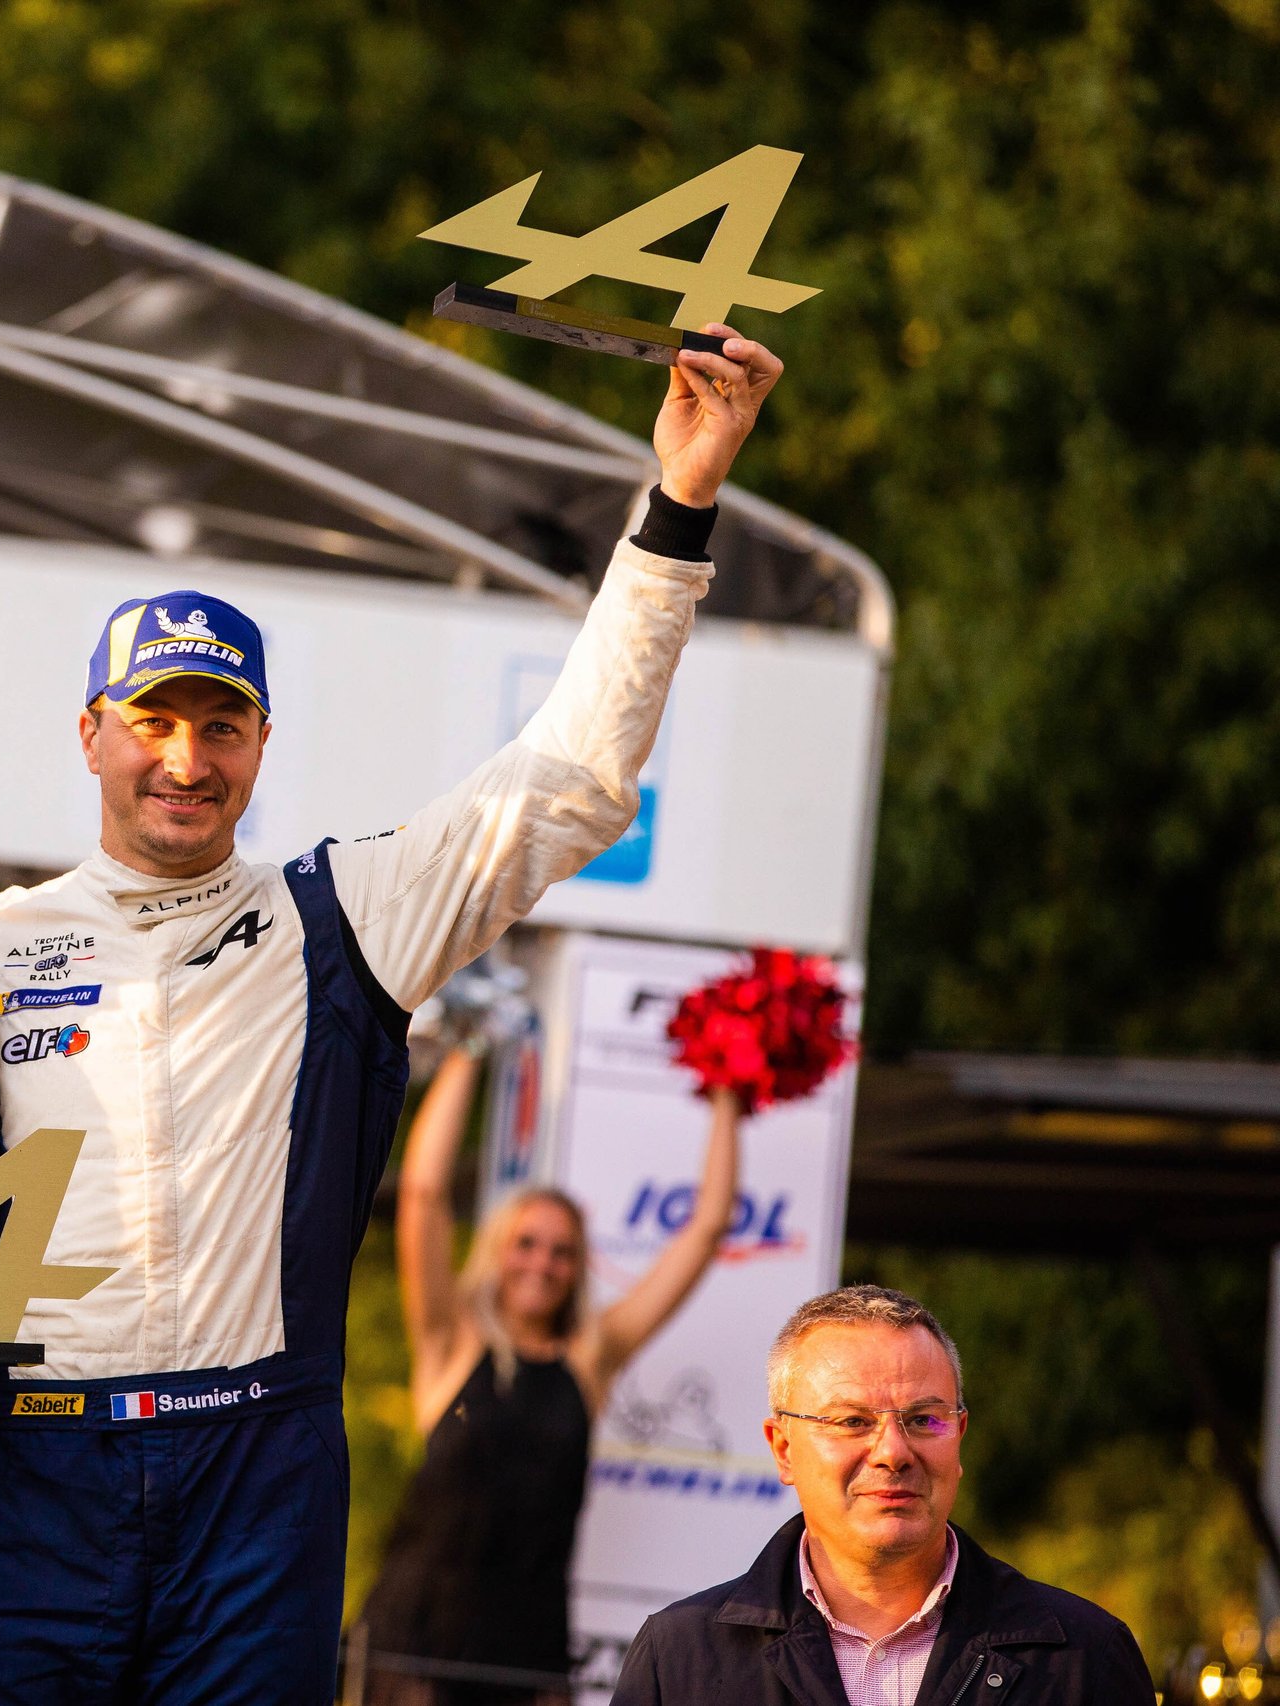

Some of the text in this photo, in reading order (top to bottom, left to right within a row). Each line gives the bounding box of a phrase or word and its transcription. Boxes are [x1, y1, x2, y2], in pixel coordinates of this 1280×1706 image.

[135, 641, 244, 667] MICHELIN
[138, 880, 232, 914] ALPINE
[7, 937, 95, 957] ALPINE
[29, 970, 71, 981] RALLY
[22, 990, 92, 1006] MICHELIN
[2, 1027, 58, 1064] elf
[20, 1397, 77, 1413] Sabelt
[159, 1388, 241, 1412] Saunier
